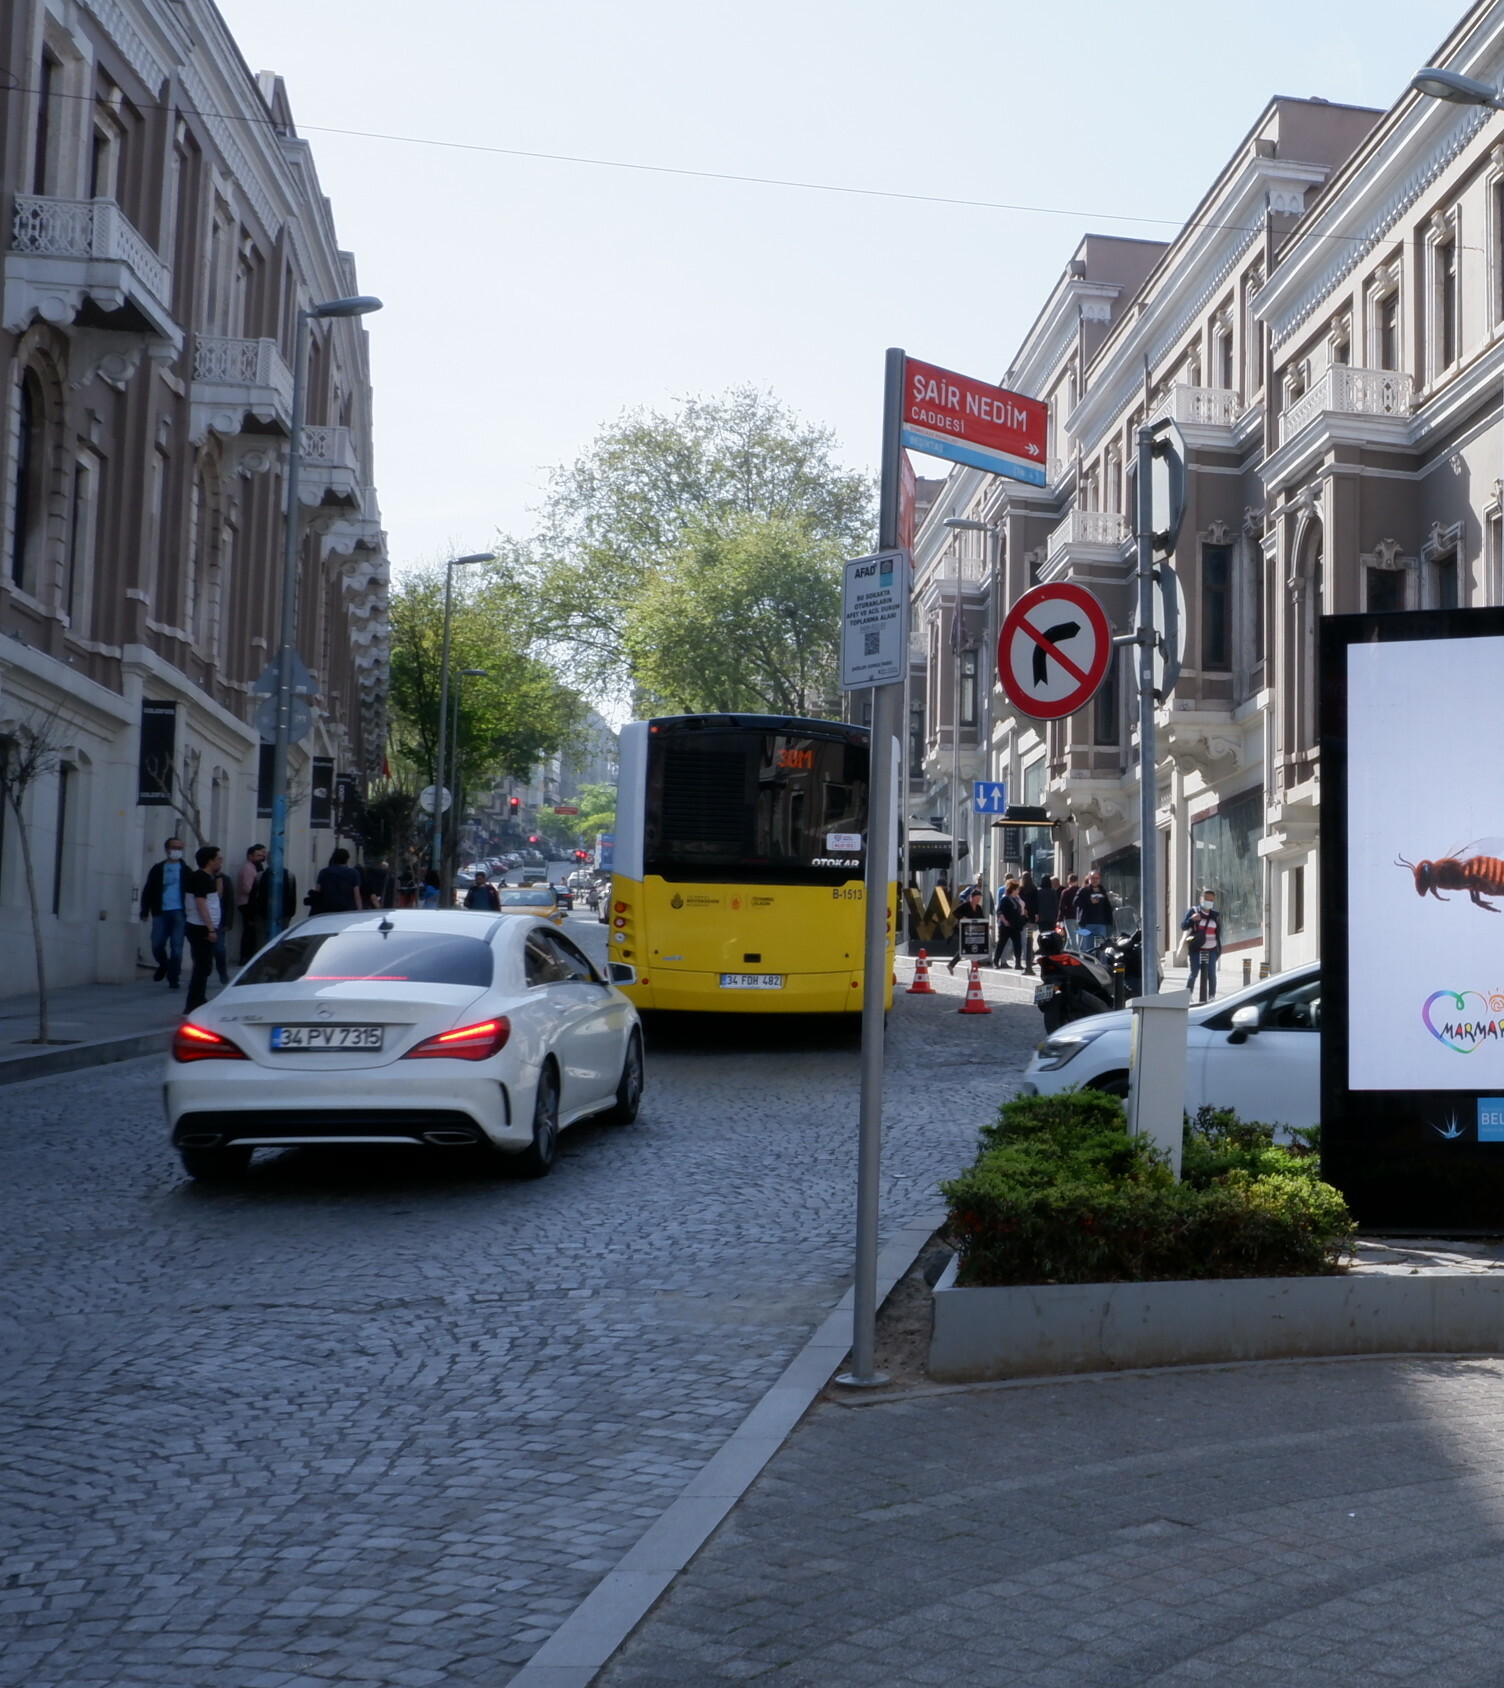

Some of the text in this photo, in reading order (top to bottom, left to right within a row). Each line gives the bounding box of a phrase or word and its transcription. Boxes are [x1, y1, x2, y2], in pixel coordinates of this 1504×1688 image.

[913, 375, 1028, 433] ŞAİR NEDİM
[911, 406, 965, 433] CADDESİ
[854, 566, 876, 579] AFAD
[832, 887, 863, 900] B-1513
[727, 975, 780, 986] 34 FDH 482
[282, 1028, 381, 1046] 34 PV 7315
